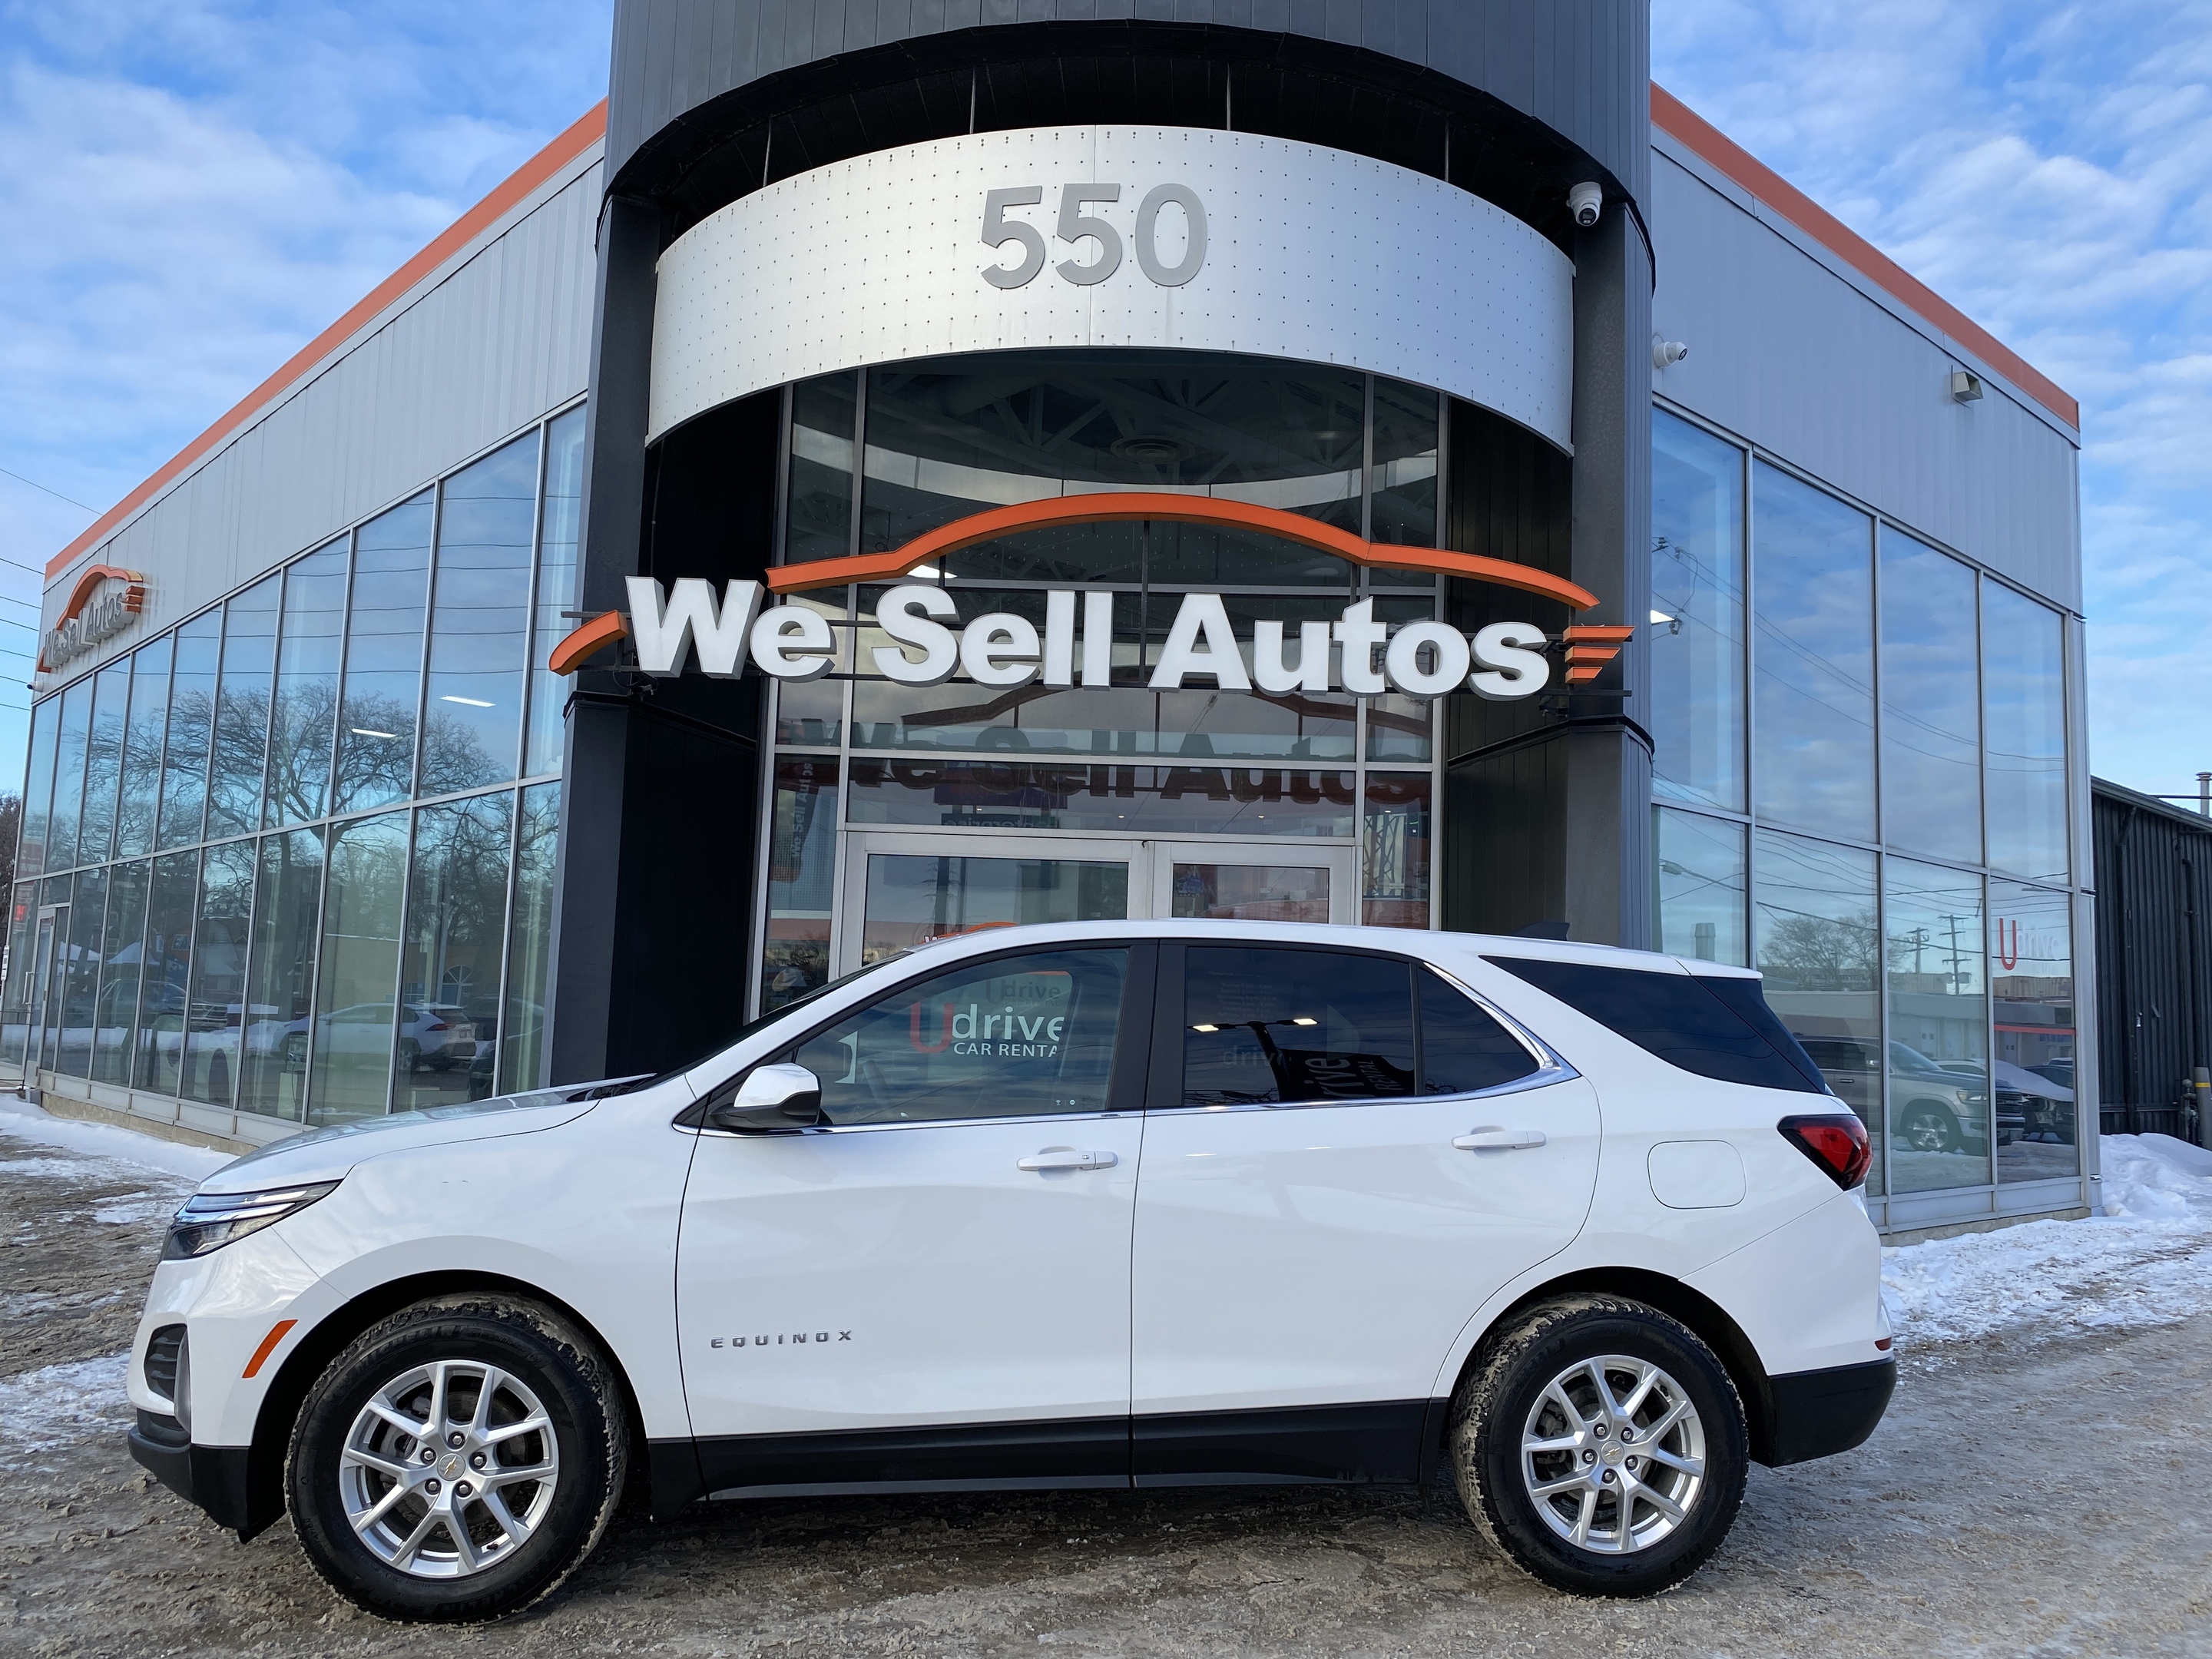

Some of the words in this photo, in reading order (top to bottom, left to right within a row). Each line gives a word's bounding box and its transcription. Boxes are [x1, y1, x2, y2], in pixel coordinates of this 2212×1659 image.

[981, 182, 1207, 290] 550
[44, 628, 63, 667] We
[60, 608, 86, 655] Sell
[85, 592, 127, 644] Autos
[625, 576, 837, 684] We
[872, 584, 1114, 691] Sell
[1147, 593, 1551, 701] Autos
[793, 807, 806, 832] Sell
[953, 1042, 992, 1056] CAR
[1357, 1060, 1405, 1091] RENTAL
[710, 1330, 852, 1349] EQUINOX
